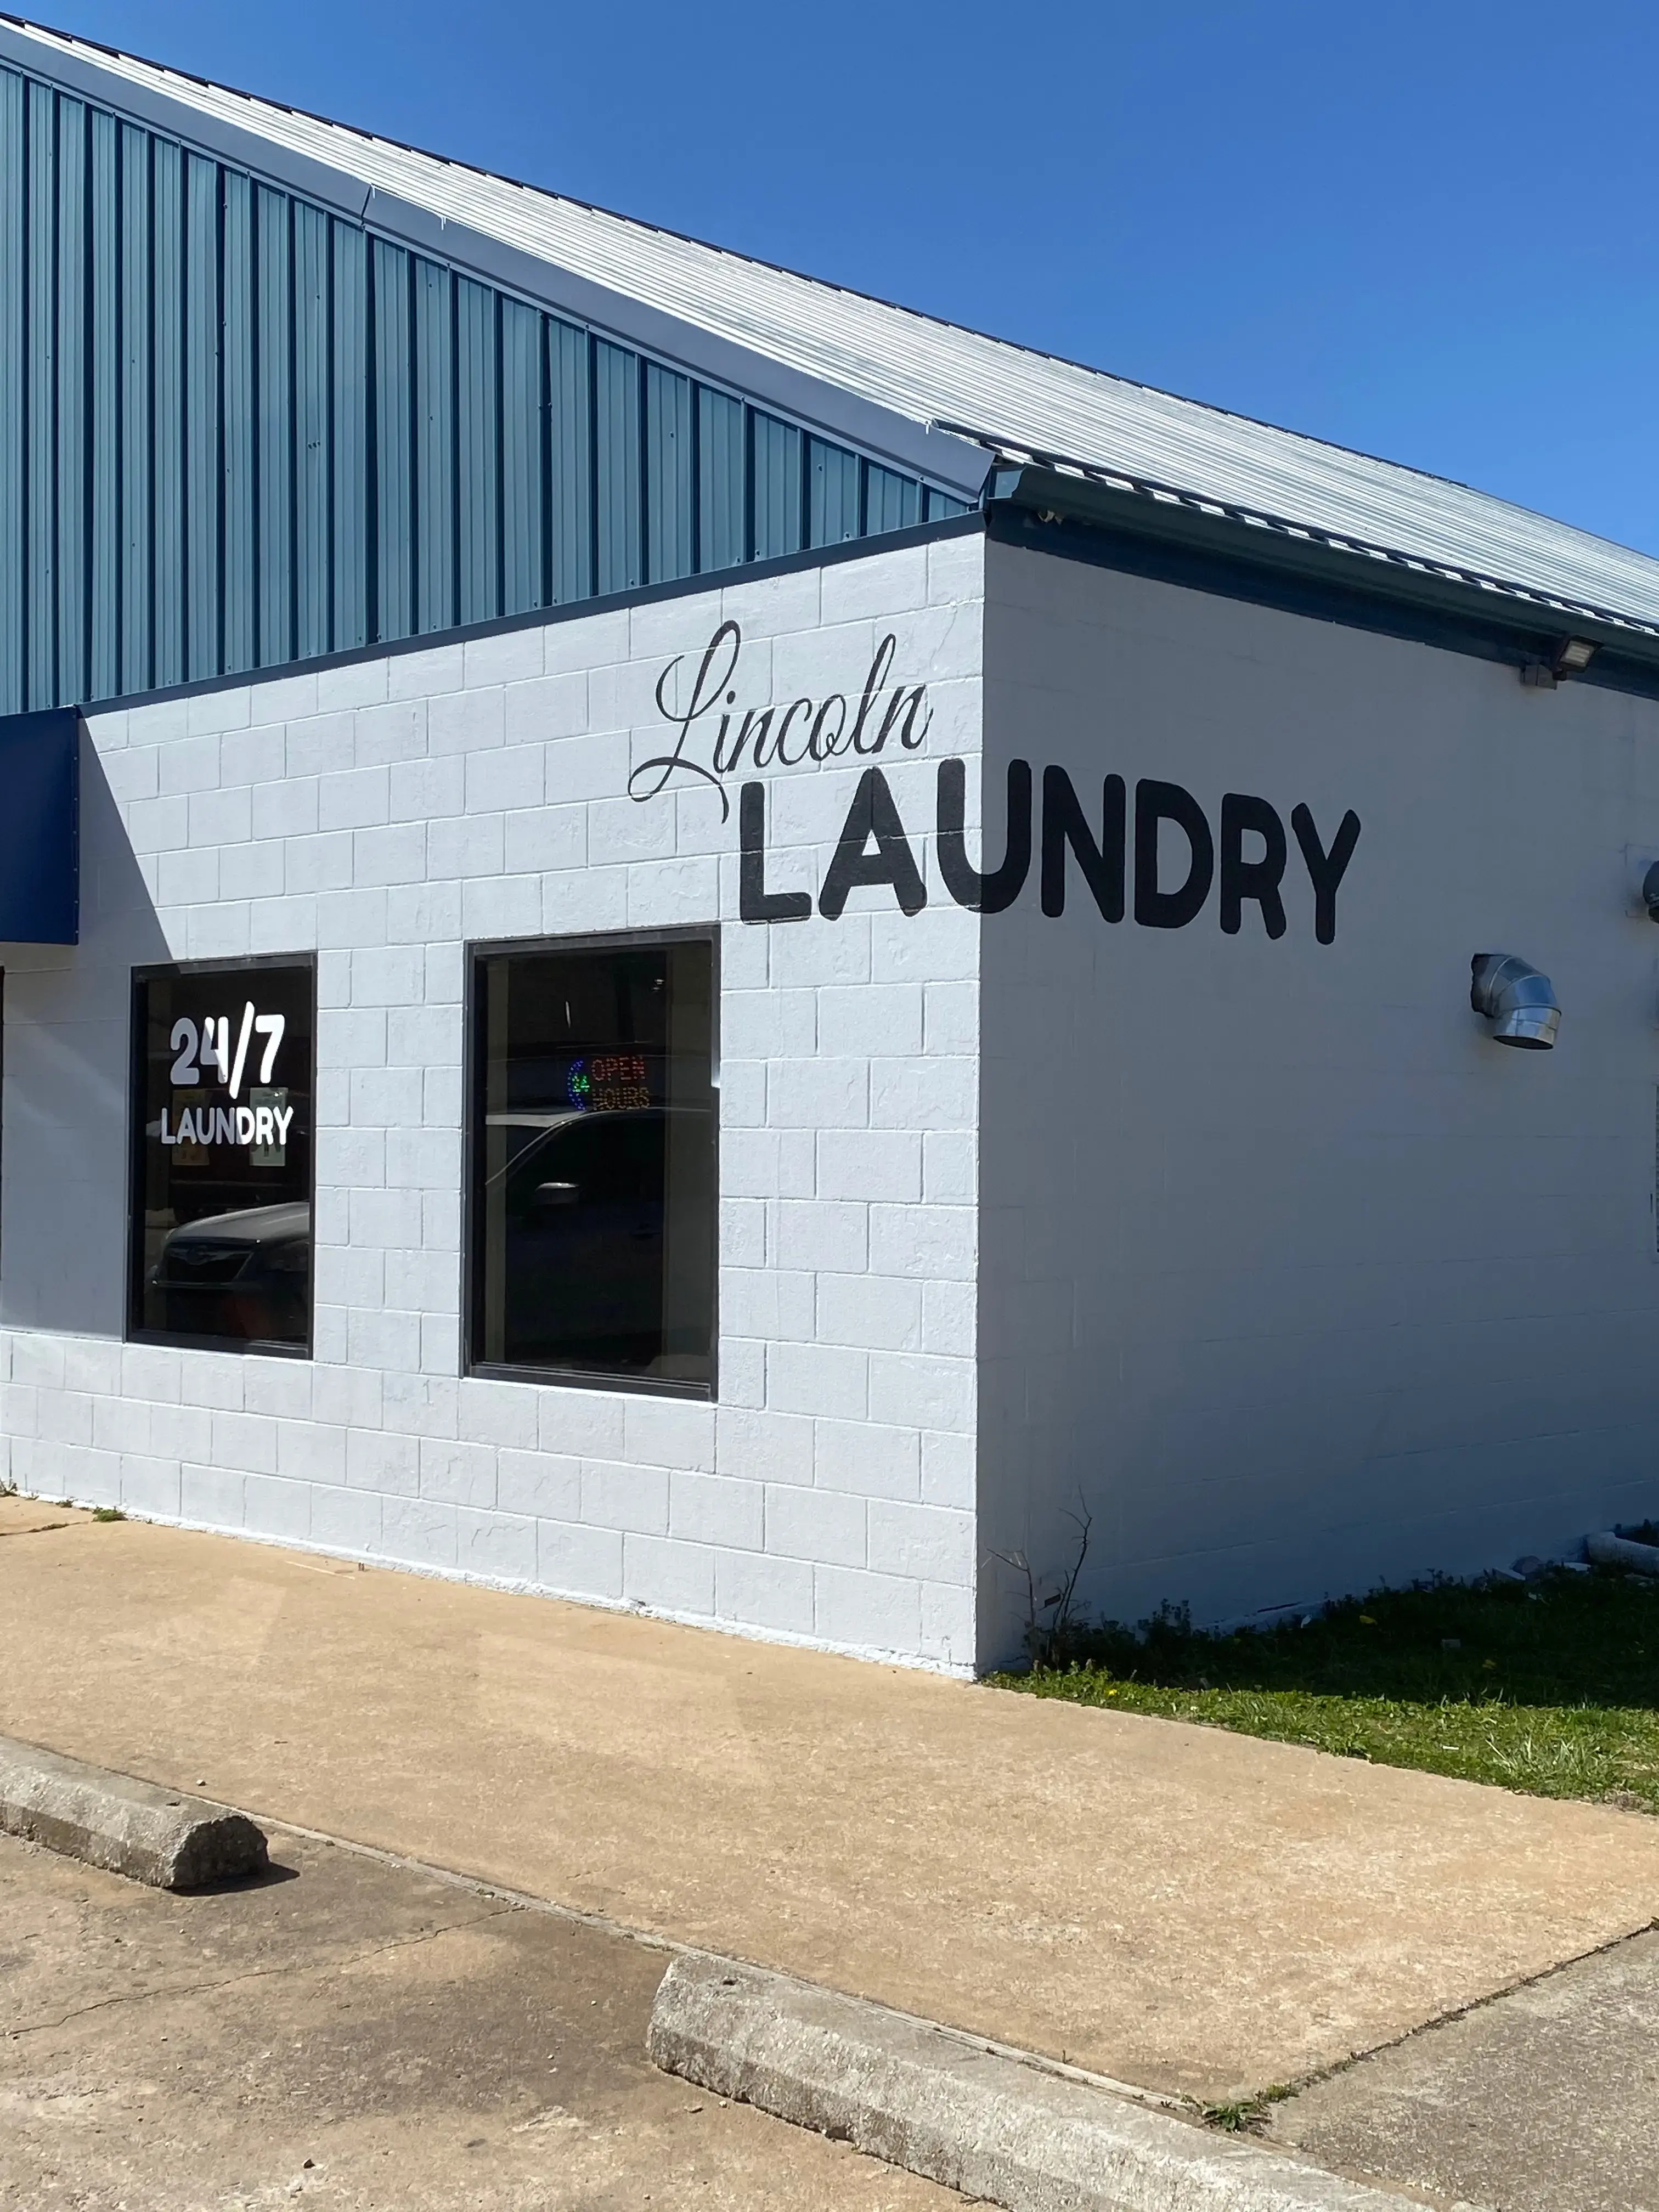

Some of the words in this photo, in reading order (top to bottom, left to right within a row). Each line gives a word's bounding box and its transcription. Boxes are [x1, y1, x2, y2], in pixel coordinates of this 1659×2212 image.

[627, 619, 933, 824] Lincoln
[740, 758, 1362, 945] LAUNDRY
[170, 1001, 285, 1099] 24/7
[591, 1056, 646, 1081] OPEN
[161, 1106, 294, 1145] LAUNDRY
[592, 1087, 650, 1111] HOURS
